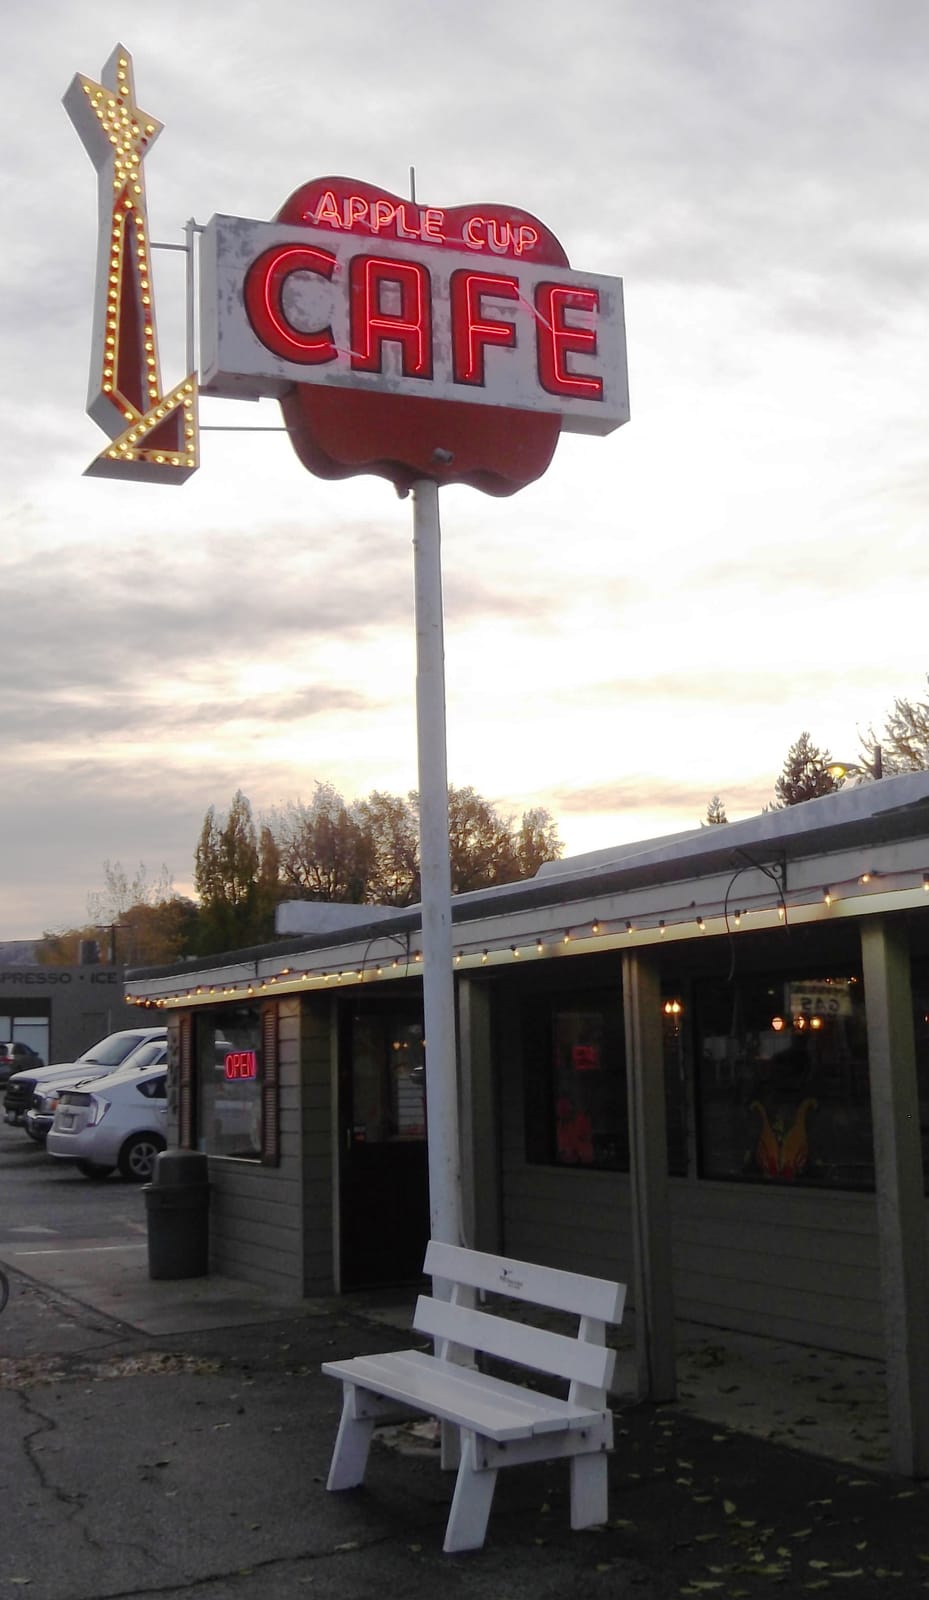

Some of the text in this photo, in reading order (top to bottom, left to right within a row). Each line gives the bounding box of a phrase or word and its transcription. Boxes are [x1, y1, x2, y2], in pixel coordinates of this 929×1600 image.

[314, 191, 538, 256] APPLE CUP
[244, 243, 603, 402] CAFE
[0, 972, 118, 984] PRESSO ICE
[225, 1052, 256, 1079] OPEN
